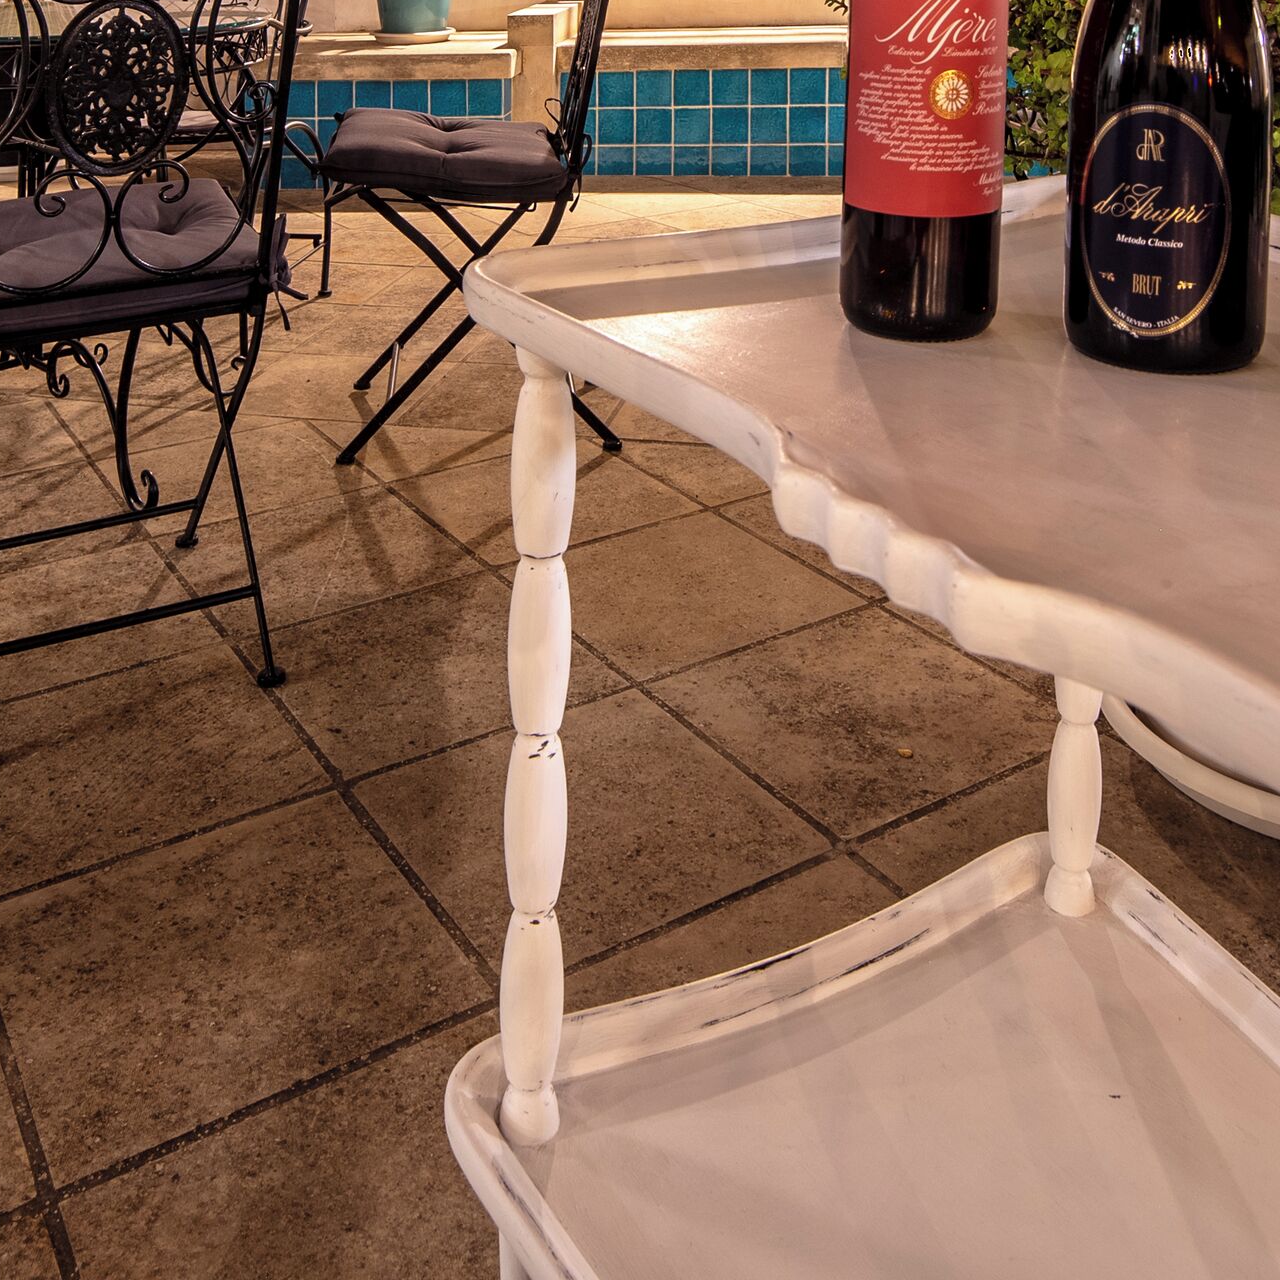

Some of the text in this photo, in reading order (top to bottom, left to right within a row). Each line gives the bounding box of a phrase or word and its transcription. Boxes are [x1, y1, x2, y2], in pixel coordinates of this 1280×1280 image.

[887, 45, 925, 57] Edizione
[1116, 233, 1184, 250] Metodo Classico
[1132, 273, 1163, 297] BRUT
[1125, 315, 1153, 329] SEVERO
[1156, 315, 1181, 329] ITALIA
